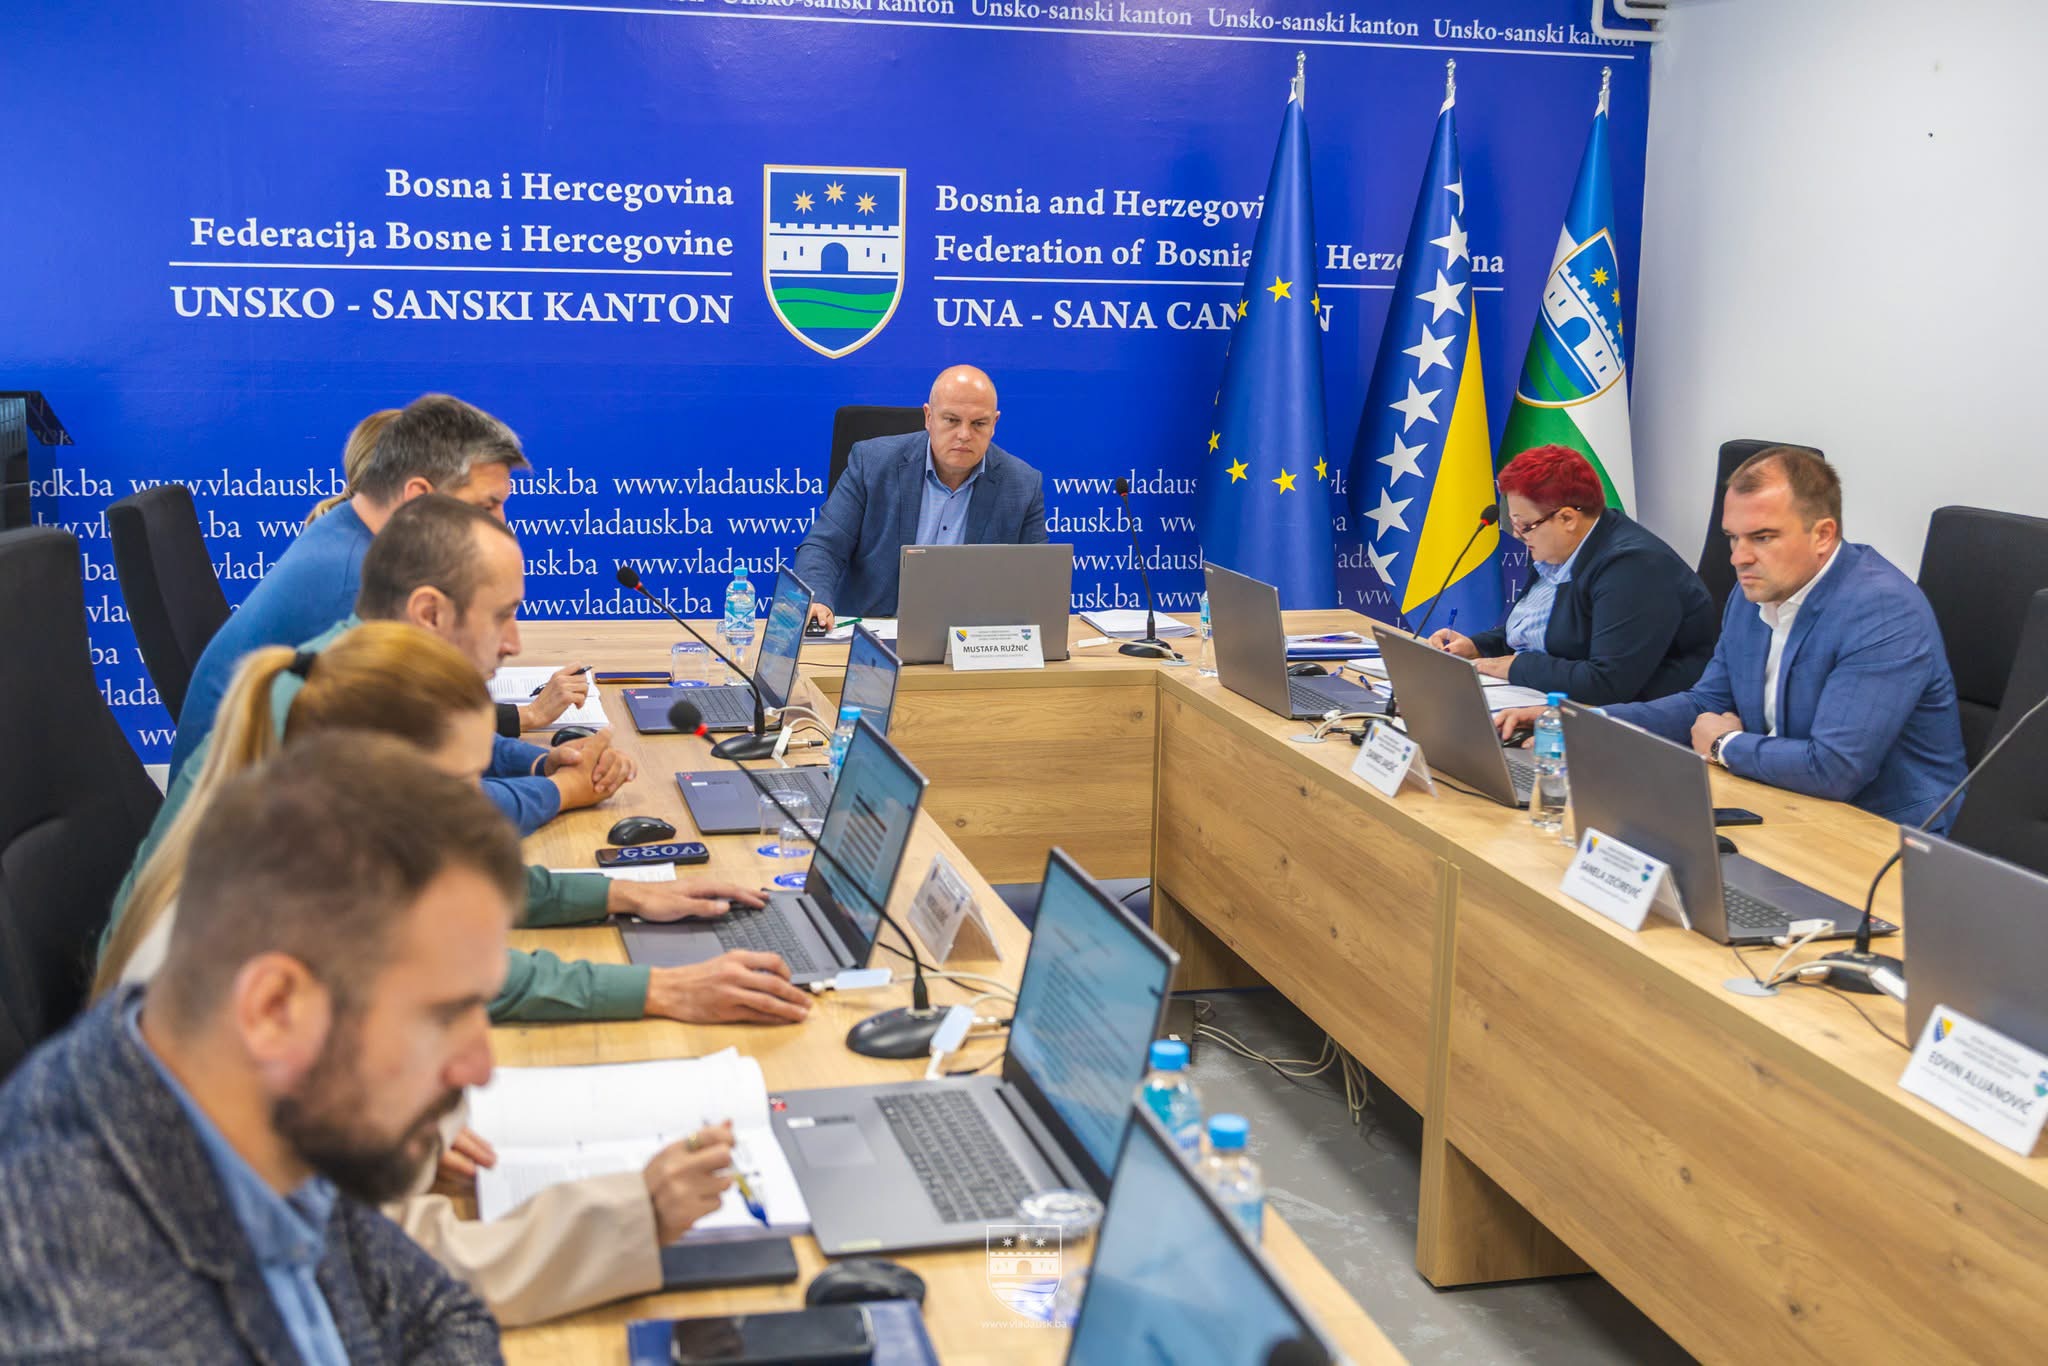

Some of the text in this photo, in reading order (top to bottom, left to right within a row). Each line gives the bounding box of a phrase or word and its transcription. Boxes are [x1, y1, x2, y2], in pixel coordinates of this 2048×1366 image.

[972, 0, 1113, 22] Unsko-sanski
[1119, 2, 1192, 26] kanton
[1208, 8, 1344, 32] Unsko-sanski
[1350, 13, 1418, 36] kanton
[1434, 19, 1563, 43] Unsko-sanski
[386, 169, 734, 211] Bosna i Hercegovina
[936, 186, 1264, 227] Bosnia and Herzegovi
[191, 218, 733, 263] Federacija Bosne i Hercegovine
[935, 235, 1103, 262] Federation
[1112, 238, 1144, 264] of
[1156, 241, 1252, 267] Bosnia
[170, 287, 335, 318] UNSKO
[373, 288, 533, 321] SANSKI
[544, 291, 733, 324] KANTON
[934, 298, 1024, 327] UNA
[1053, 299, 1157, 328] SANA
[1166, 301, 1334, 332] CANN
[129, 468, 347, 496] ww.vladausk.b
[612, 468, 824, 494] www.vladausk.ba
[506, 508, 713, 535] www.vladausk.ba
[1045, 507, 1143, 533] dausk.ba
[612, 547, 793, 574] www.vladausk.
[514, 588, 712, 615] ww.vladausk.ba
[963, 645, 999, 653] MUSTAFA
[1928, 1051, 1963, 1077] EDVIN
